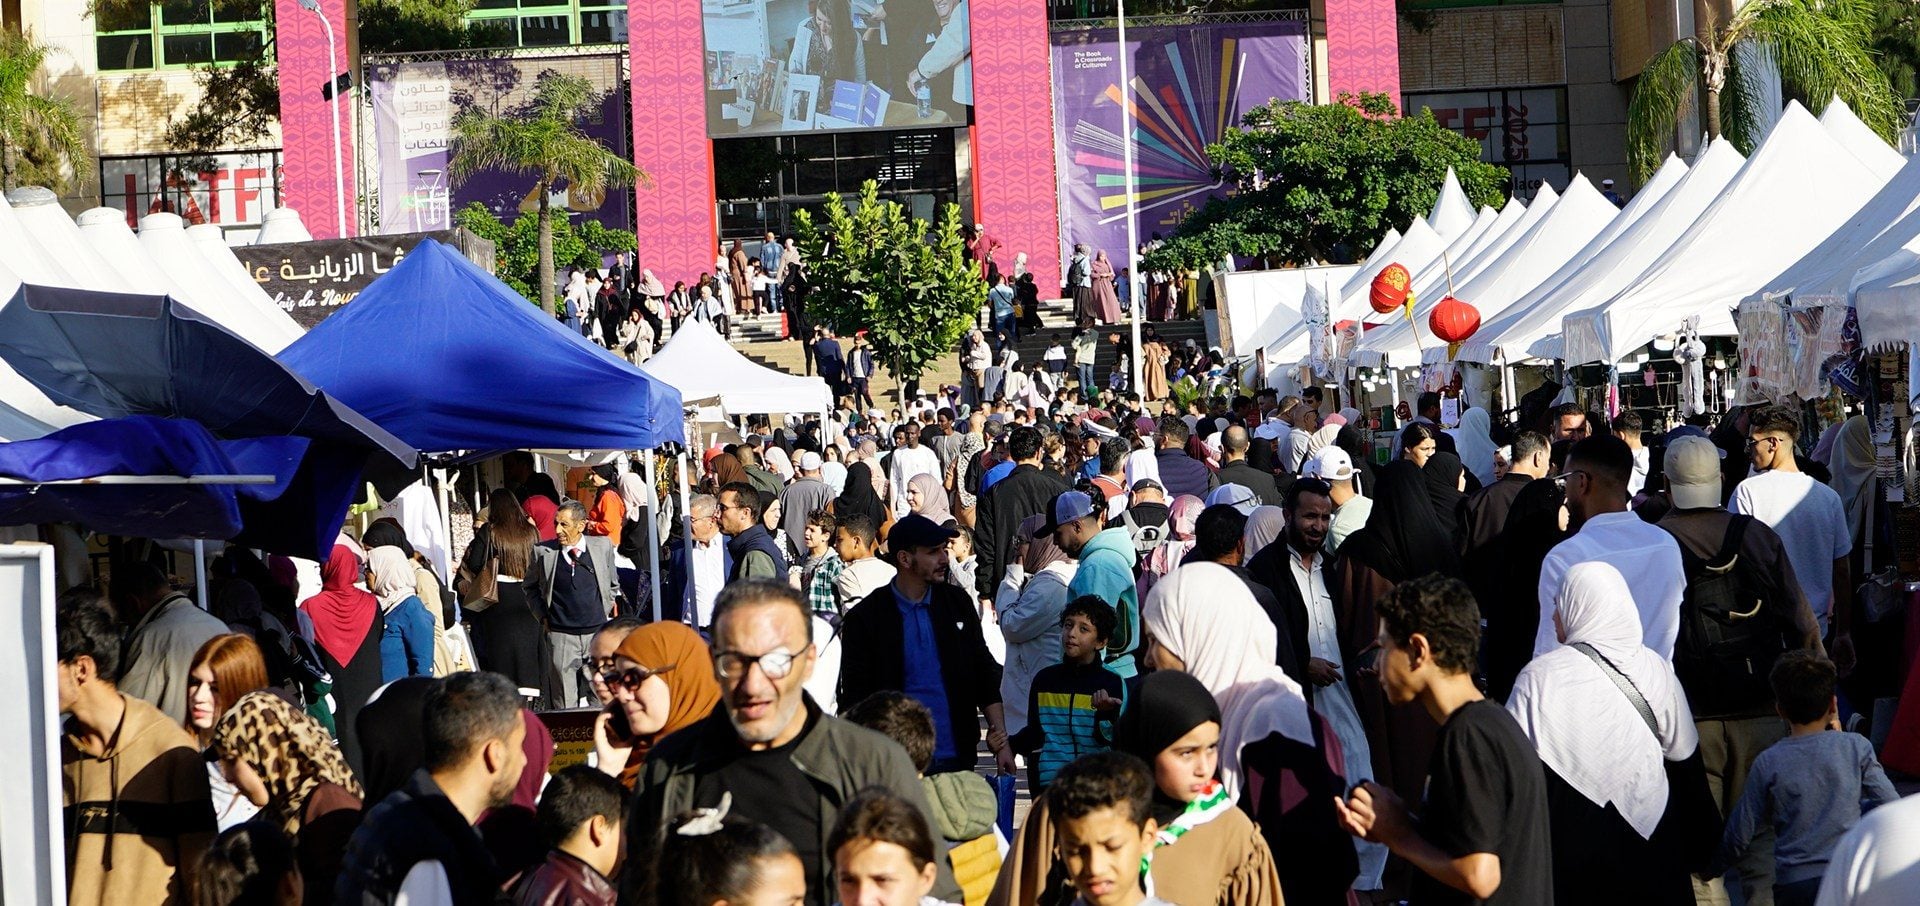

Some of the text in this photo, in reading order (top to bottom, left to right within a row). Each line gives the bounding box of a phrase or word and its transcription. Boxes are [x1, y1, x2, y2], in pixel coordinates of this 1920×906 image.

[400, 84, 445, 97] صالون
[1502, 104, 1529, 160] 2025
[1513, 176, 1541, 191] lace
[124, 167, 267, 230] IATF
[297, 289, 317, 307] du
